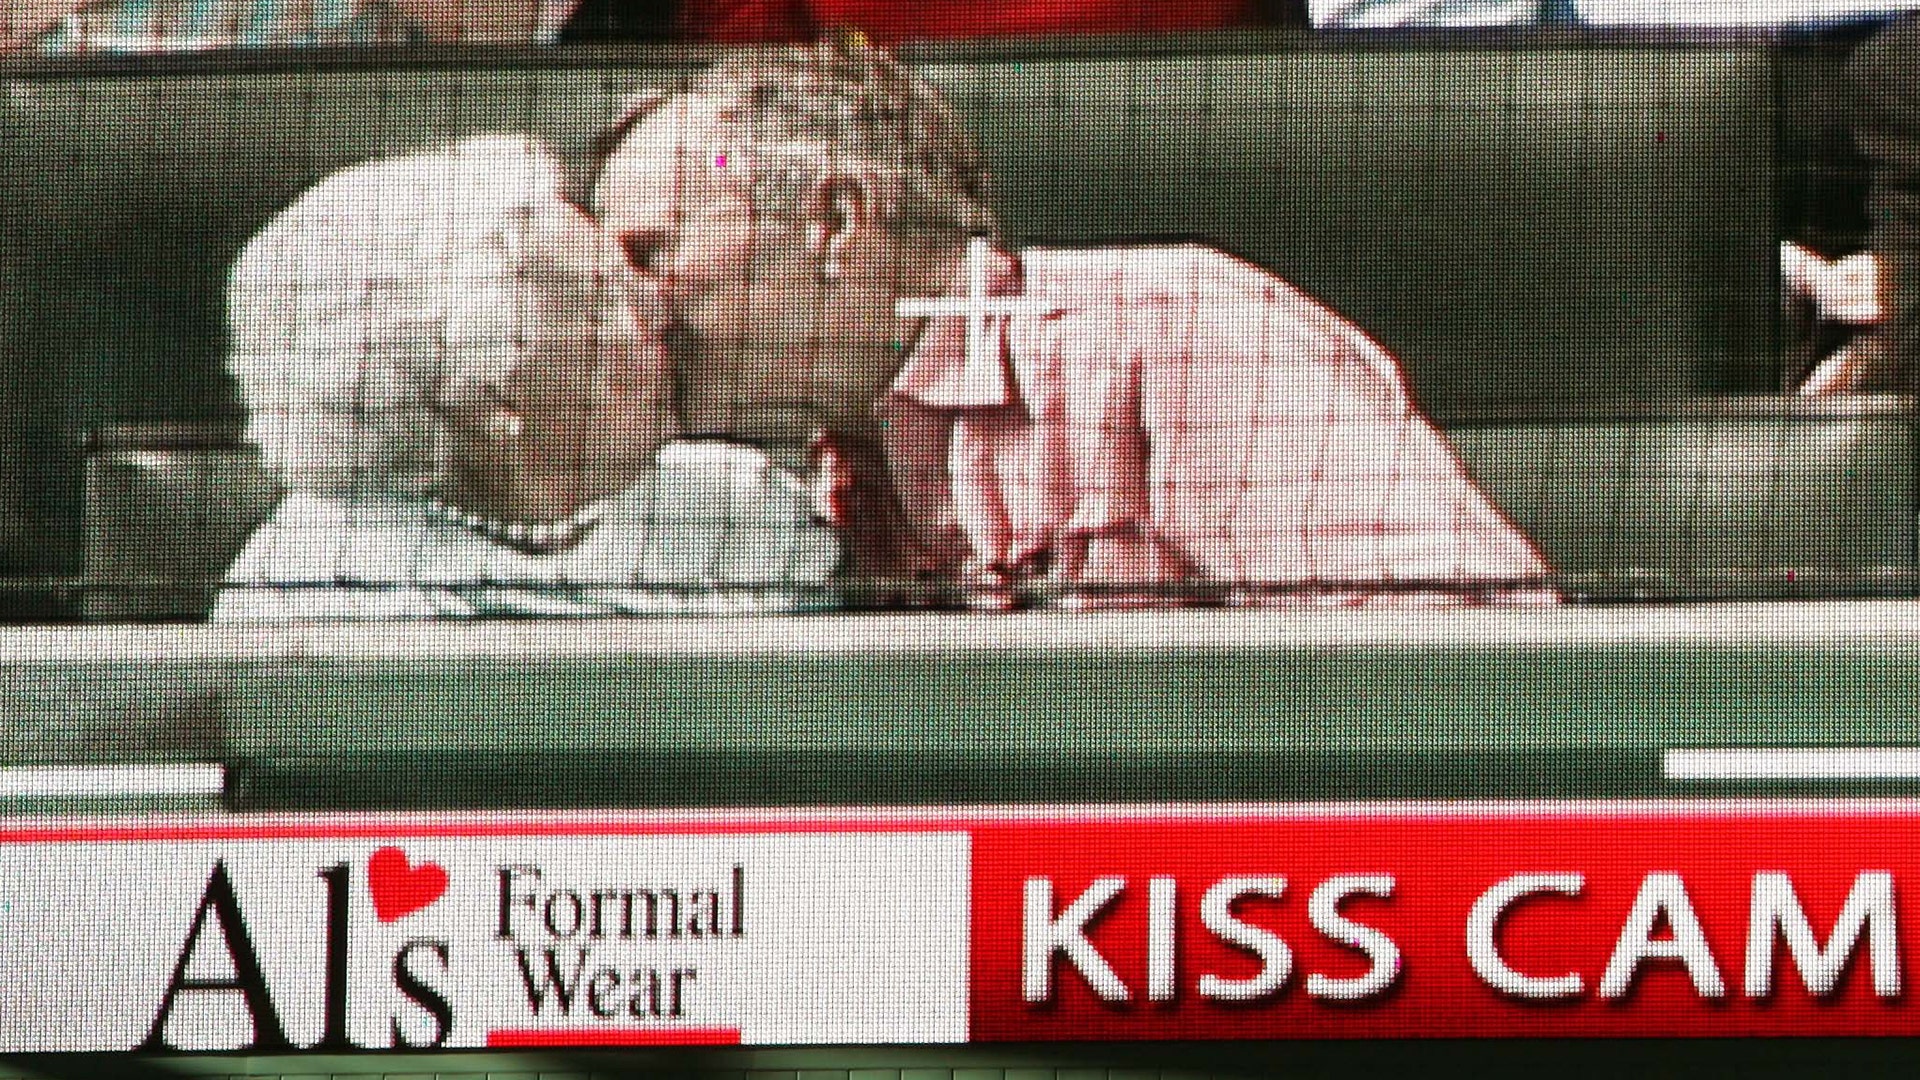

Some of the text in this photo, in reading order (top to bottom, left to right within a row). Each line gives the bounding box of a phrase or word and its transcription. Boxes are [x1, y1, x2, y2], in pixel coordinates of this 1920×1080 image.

[495, 863, 745, 940] Formal
[1021, 870, 1902, 1004] KISS CAM
[511, 948, 699, 1019] Wear
